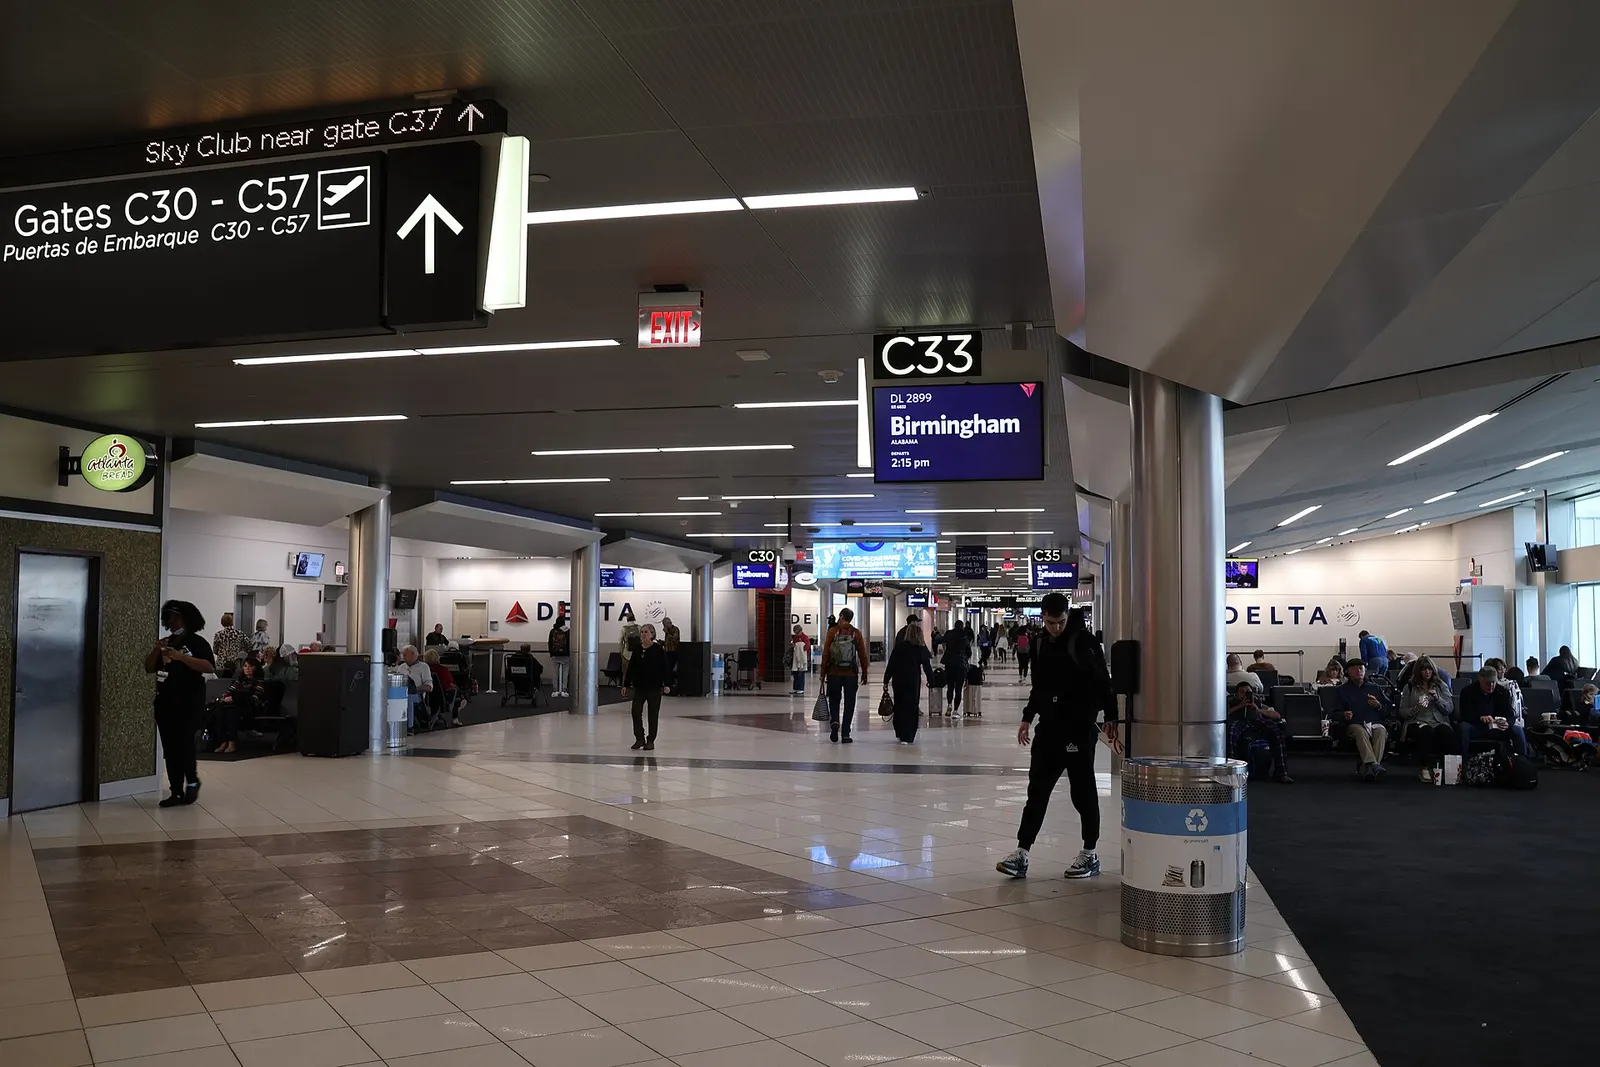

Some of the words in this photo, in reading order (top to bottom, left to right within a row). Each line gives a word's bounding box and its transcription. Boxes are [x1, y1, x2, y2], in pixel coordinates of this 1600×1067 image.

[145, 141, 189, 165] Sky
[197, 134, 252, 158] Club
[260, 128, 315, 151] near
[323, 117, 380, 147] gate
[388, 107, 443, 135] C37
[14, 201, 112, 237] Gates
[124, 187, 197, 226] C30
[238, 173, 310, 214] C57
[3, 239, 70, 262] Puertas
[75, 236, 97, 255] de
[103, 228, 199, 254] Embarque
[210, 220, 250, 242] C30
[271, 213, 310, 234] C57
[651, 311, 693, 344] EXIT
[882, 334, 973, 375] C33
[890, 394, 904, 403] DL
[906, 393, 932, 403] 2899
[890, 413, 1020, 439] Birmingham
[87, 454, 134, 471] atlanta
[891, 458, 912, 468] 2:15
[913, 459, 930, 470] pm
[102, 471, 134, 480] BREAD
[748, 550, 775, 562] C30
[1033, 549, 1061, 562] C35
[737, 570, 769, 578] Melbourne
[1037, 570, 1072, 578] Tallahassee
[537, 602, 636, 621] DETA
